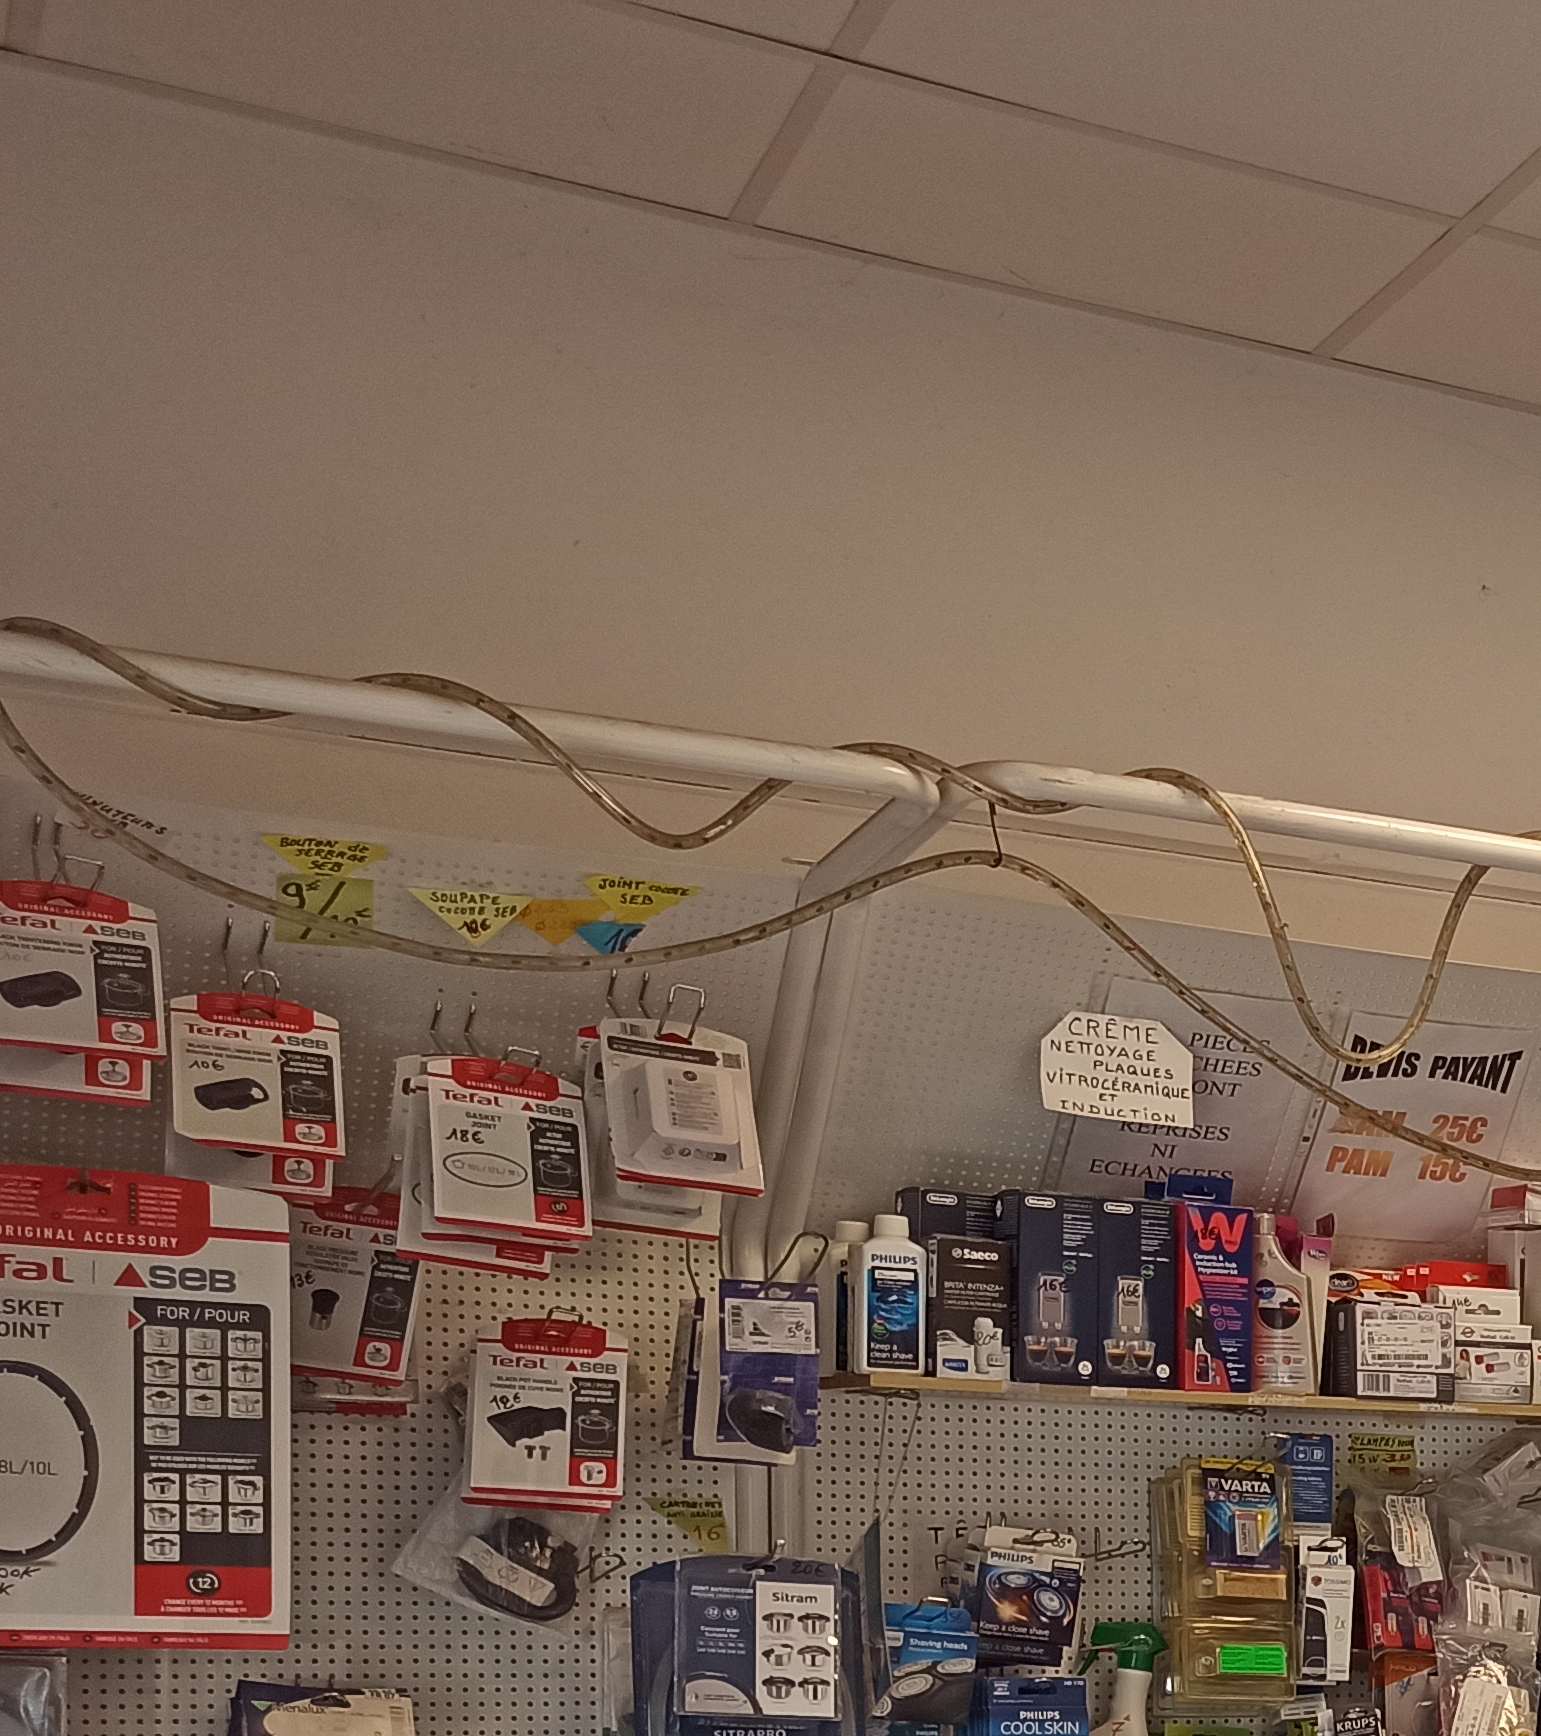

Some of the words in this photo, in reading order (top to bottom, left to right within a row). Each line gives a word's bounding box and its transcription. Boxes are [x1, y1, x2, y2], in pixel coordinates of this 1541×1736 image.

[183, 1022, 253, 1042] Tefal
[1068, 1017, 1159, 1044] CRÊME
[1050, 1040, 1156, 1062] NETTOYAGE
[1093, 1060, 1174, 1080] PLAQUES
[1428, 1050, 1524, 1093] PAYANT
[1099, 1094, 1117, 1102] ET
[1429, 1114, 1488, 1144] 25€
[1325, 1146, 1394, 1177] PAM
[157, 1306, 189, 1320] FOR
[204, 1309, 250, 1323] POUR
[1221, 1478, 1271, 1494] VARTA
[990, 1552, 1034, 1564] PHILIPS
[772, 1592, 818, 1604] Sitram
[1019, 1711, 1060, 1719] PHILIPS
[1336, 1717, 1377, 1732] KRUPS
